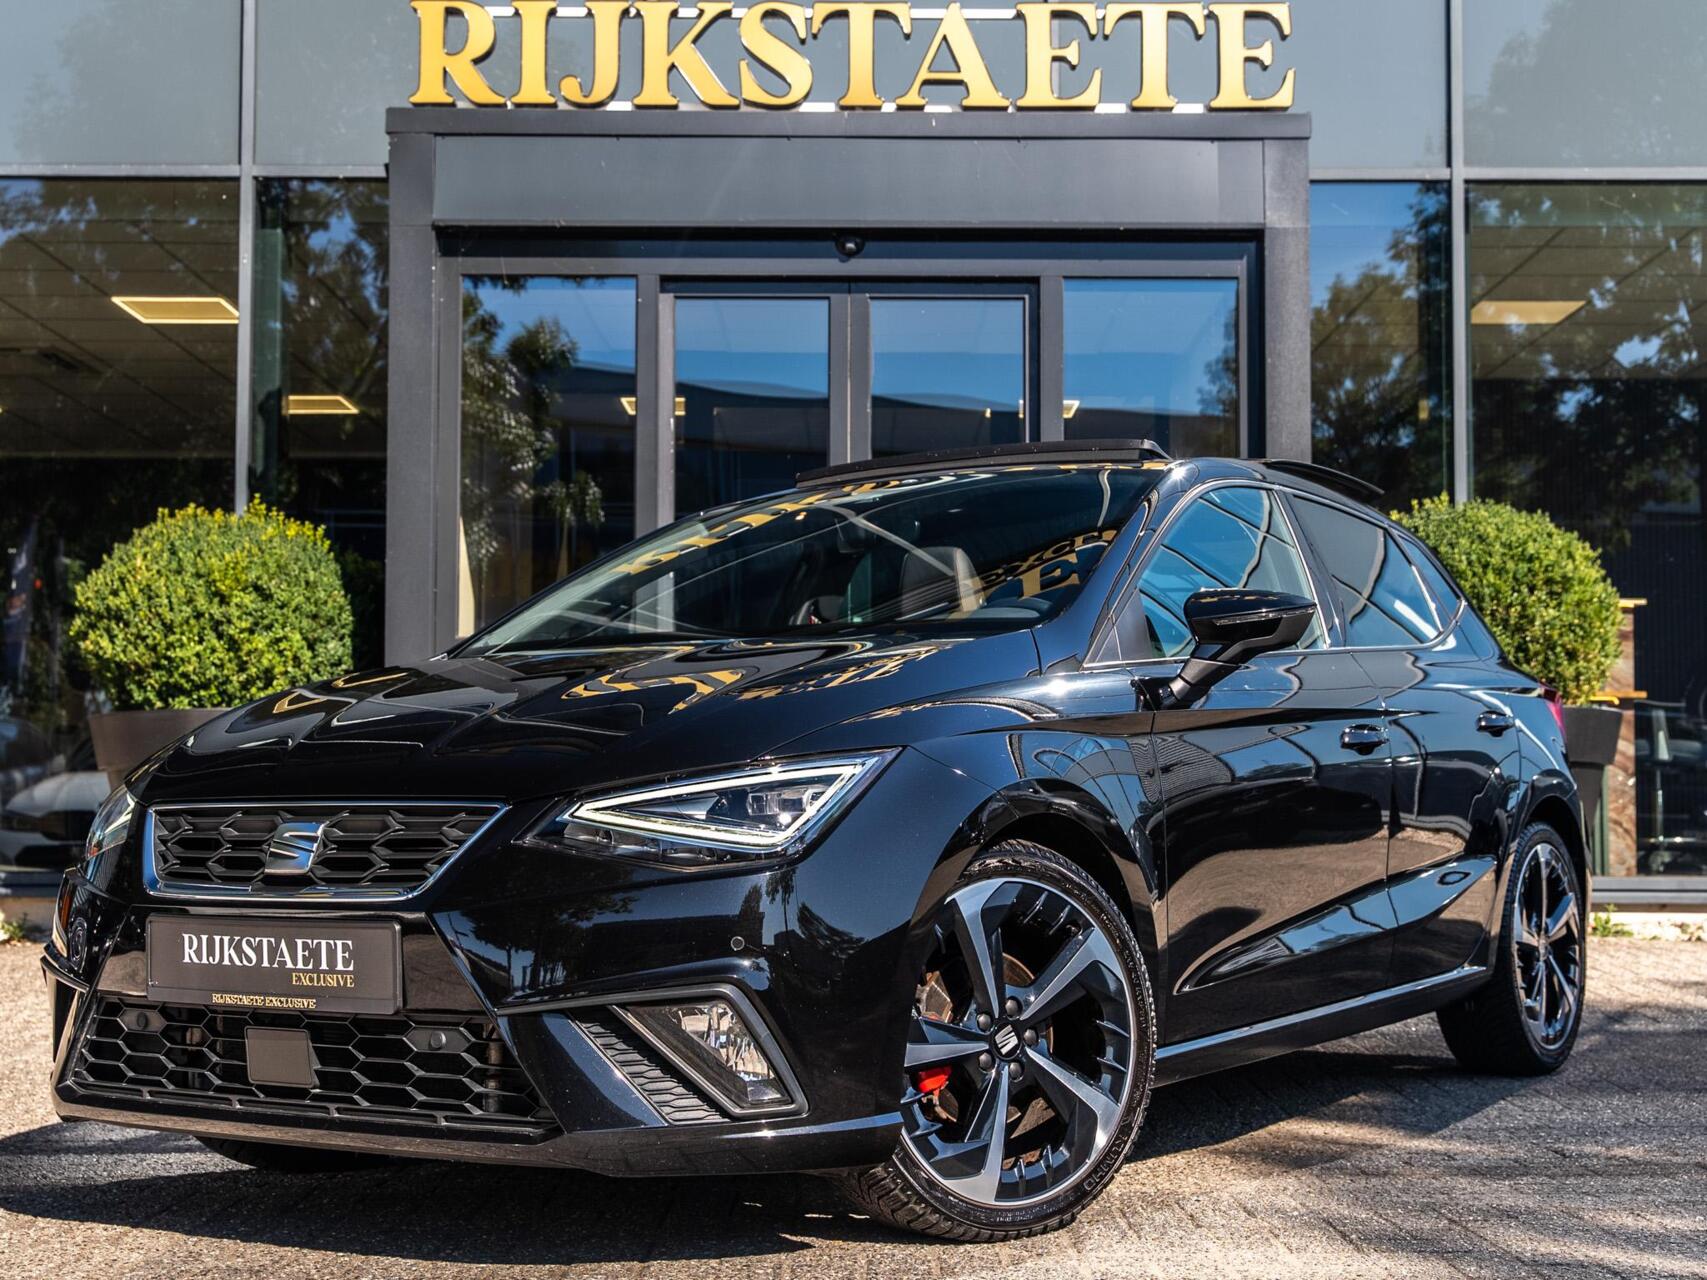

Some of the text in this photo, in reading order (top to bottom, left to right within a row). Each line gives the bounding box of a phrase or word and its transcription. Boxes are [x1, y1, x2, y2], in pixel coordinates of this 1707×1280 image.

[409, 1, 1296, 110] RIJKSTAETE
[182, 933, 355, 971] RIJKSTAETE
[292, 972, 355, 988] EXCLUSIVE
[212, 993, 317, 1009] RIJKSTAETE EXCLUSIVE
[1083, 1135, 1128, 1191] KUMHO
